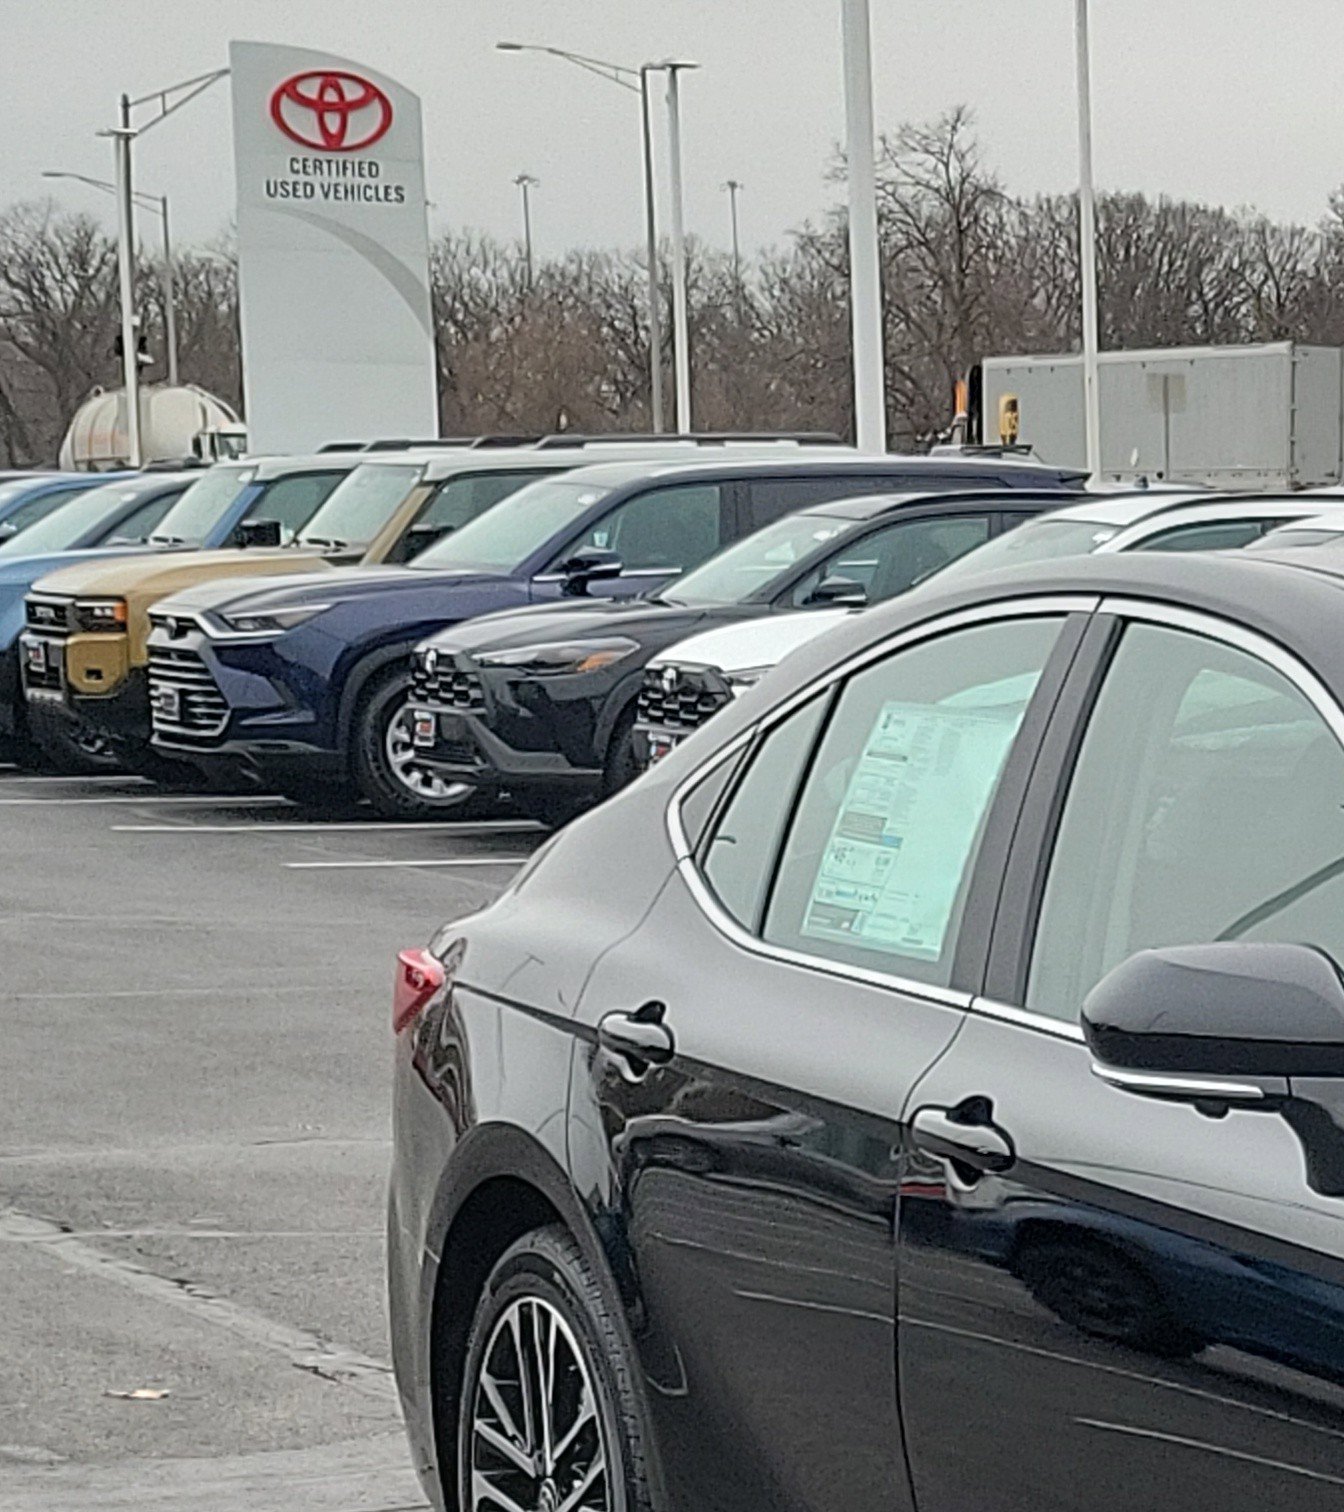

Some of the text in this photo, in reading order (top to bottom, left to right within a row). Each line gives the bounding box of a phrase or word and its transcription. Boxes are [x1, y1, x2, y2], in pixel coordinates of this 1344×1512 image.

[289, 156, 380, 179] CERTIFIED
[265, 179, 406, 204] USED VEHICLES
